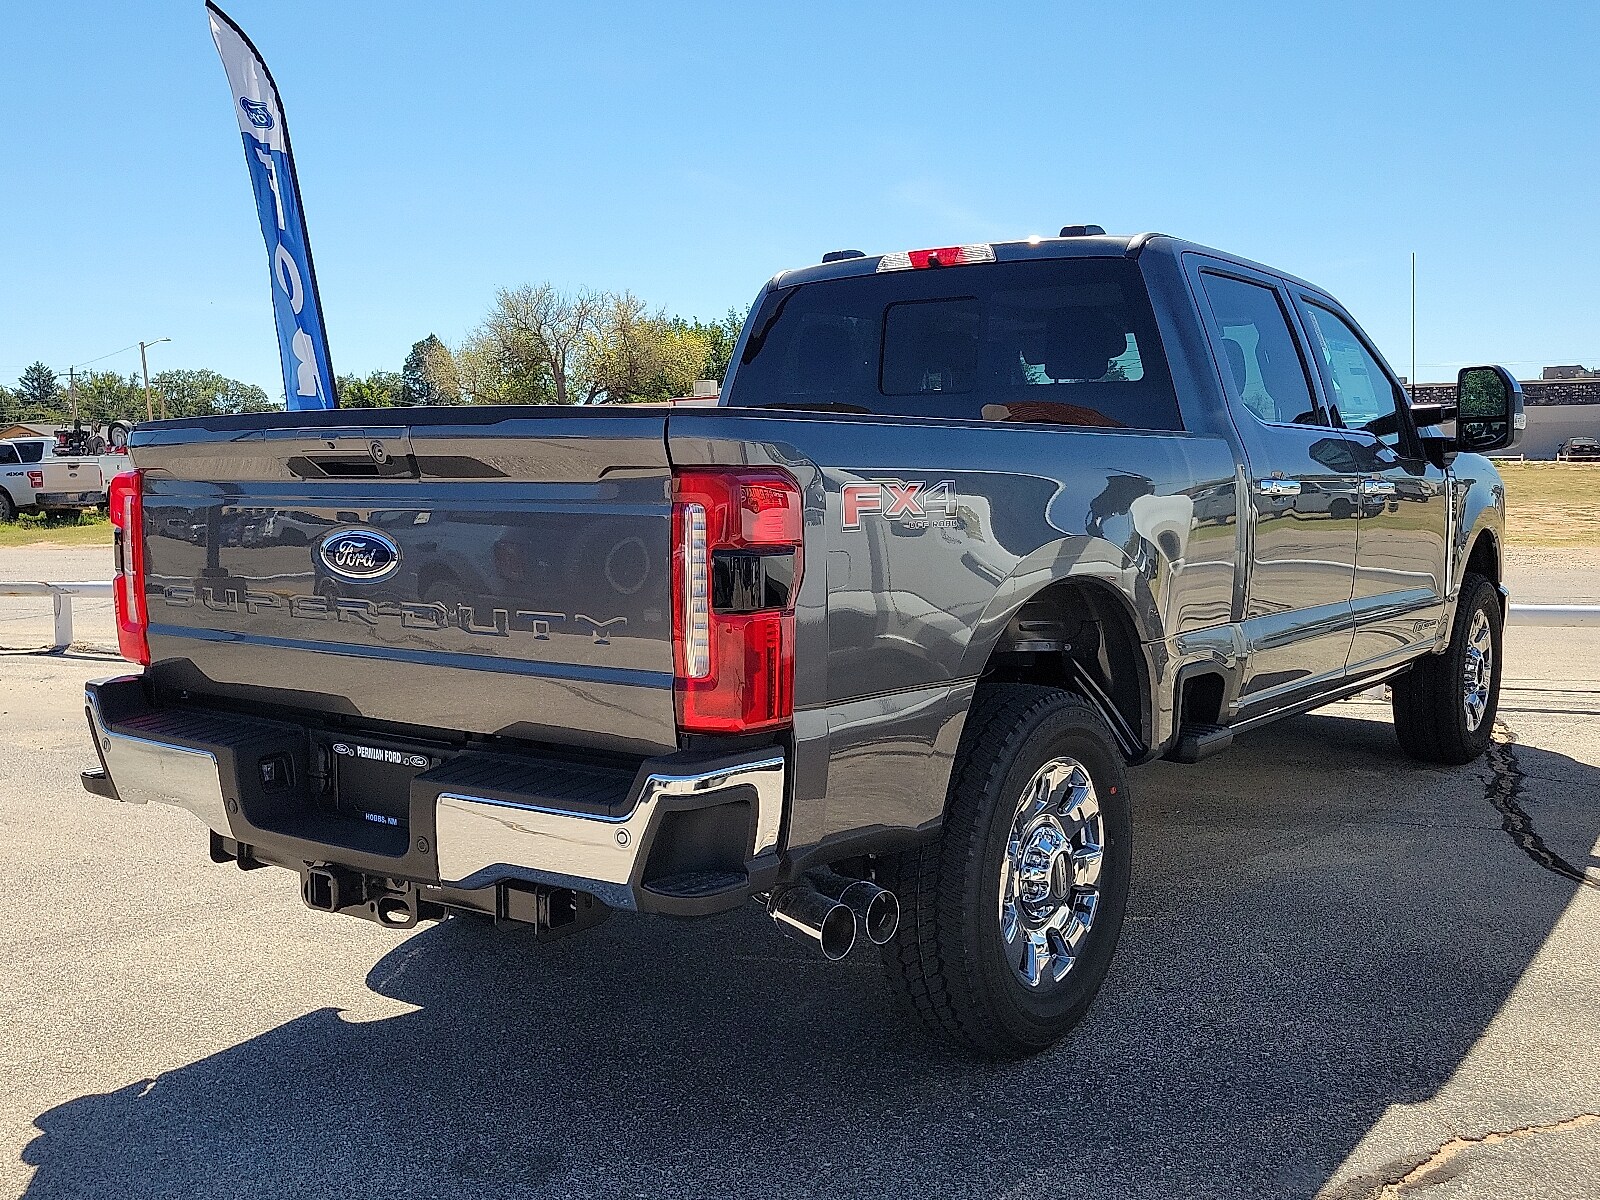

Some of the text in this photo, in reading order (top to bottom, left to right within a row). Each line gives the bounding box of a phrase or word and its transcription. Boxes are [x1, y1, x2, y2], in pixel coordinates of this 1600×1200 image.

[840, 478, 958, 533] FX4
[335, 540, 376, 567] Ford
[164, 584, 628, 646] SUPER DUTY
[357, 745, 402, 764] PERMIAN FORD
